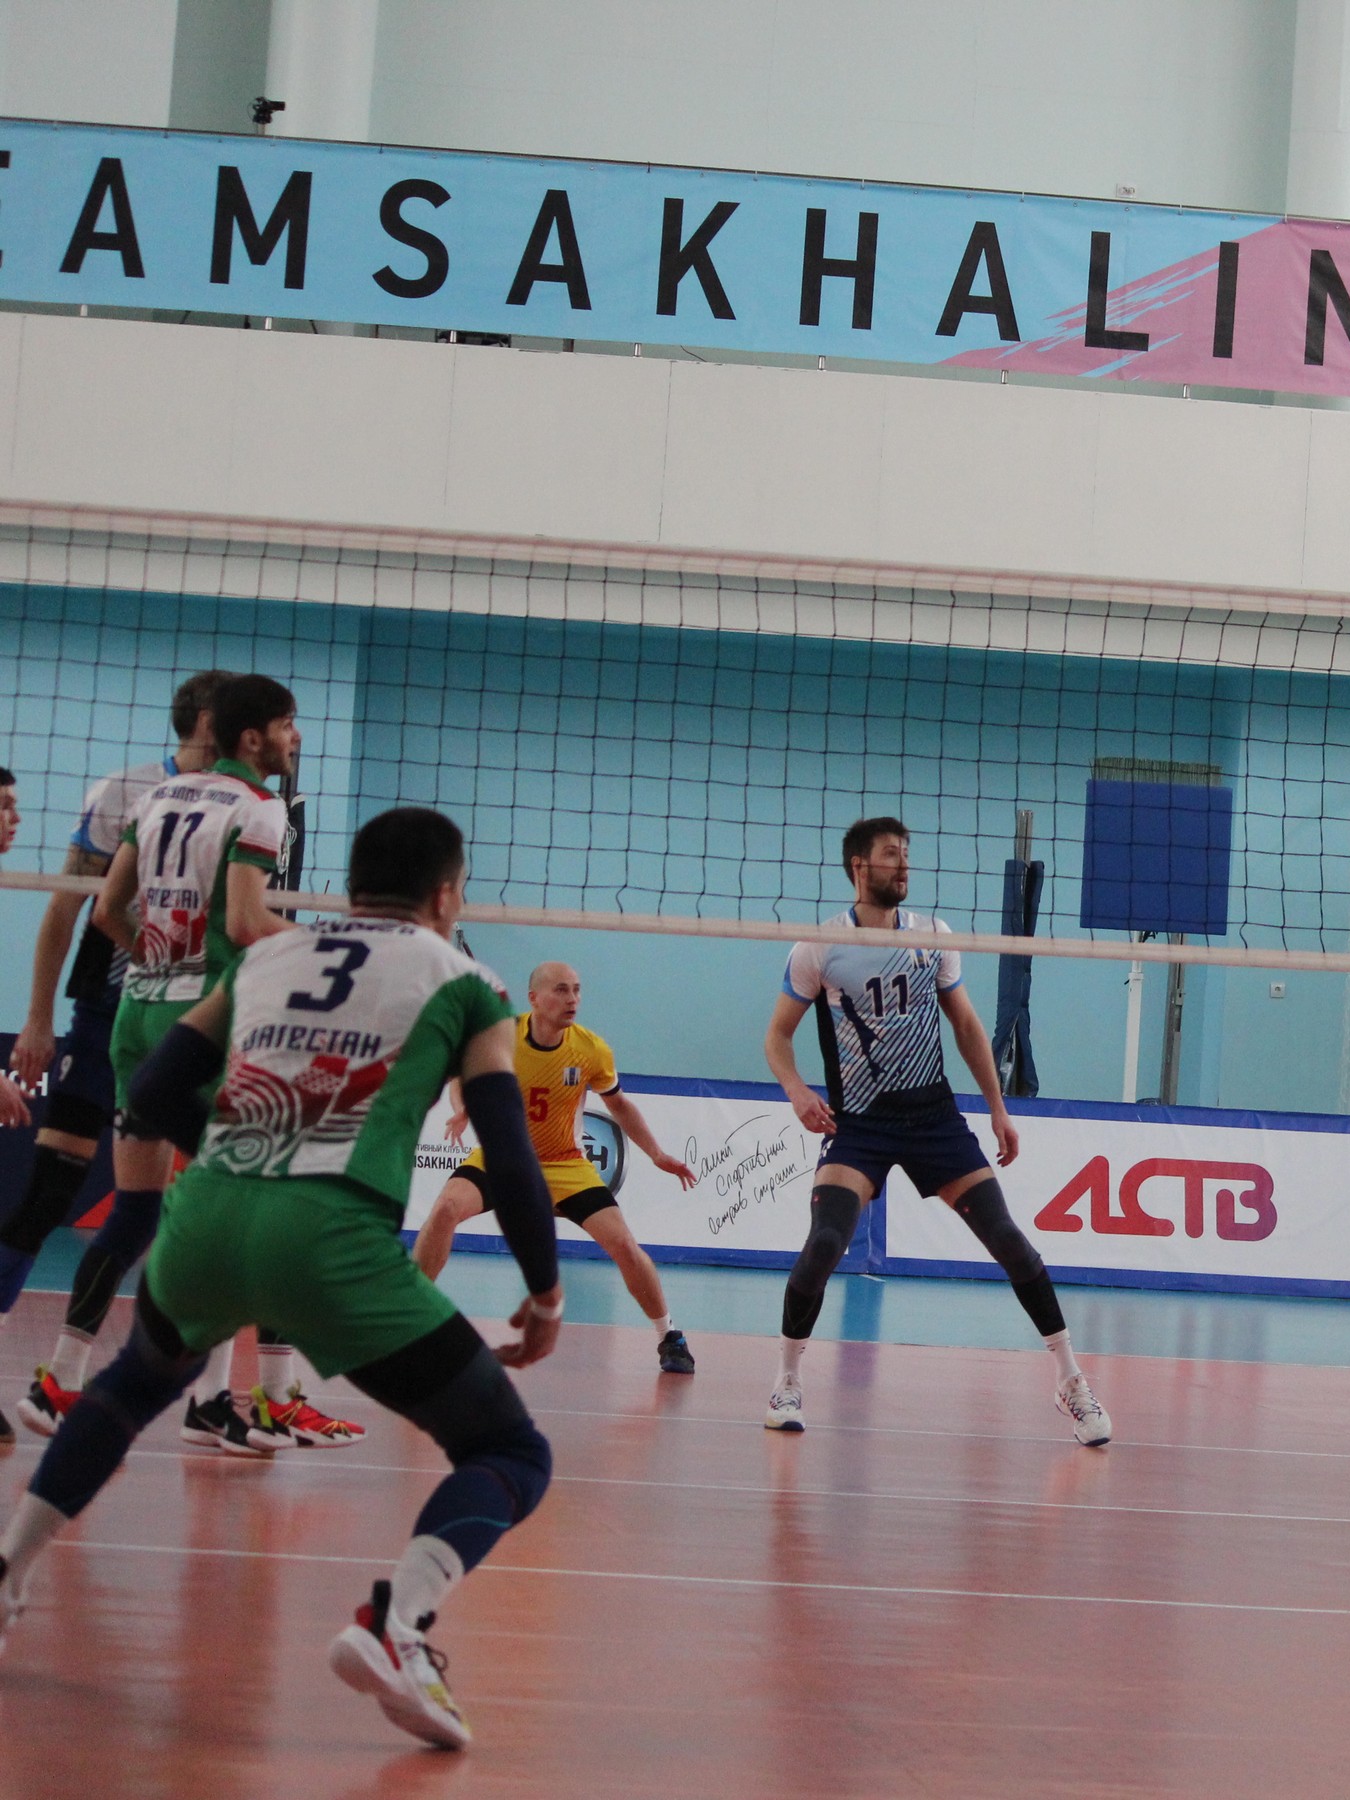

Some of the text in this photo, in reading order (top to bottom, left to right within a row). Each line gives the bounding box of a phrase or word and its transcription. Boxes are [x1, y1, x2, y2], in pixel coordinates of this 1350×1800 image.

[286, 938, 371, 1012] 3
[865, 973, 909, 1018] 11
[528, 1087, 551, 1123] 5
[414, 1144, 443, 1153] ТИВНЫЙ
